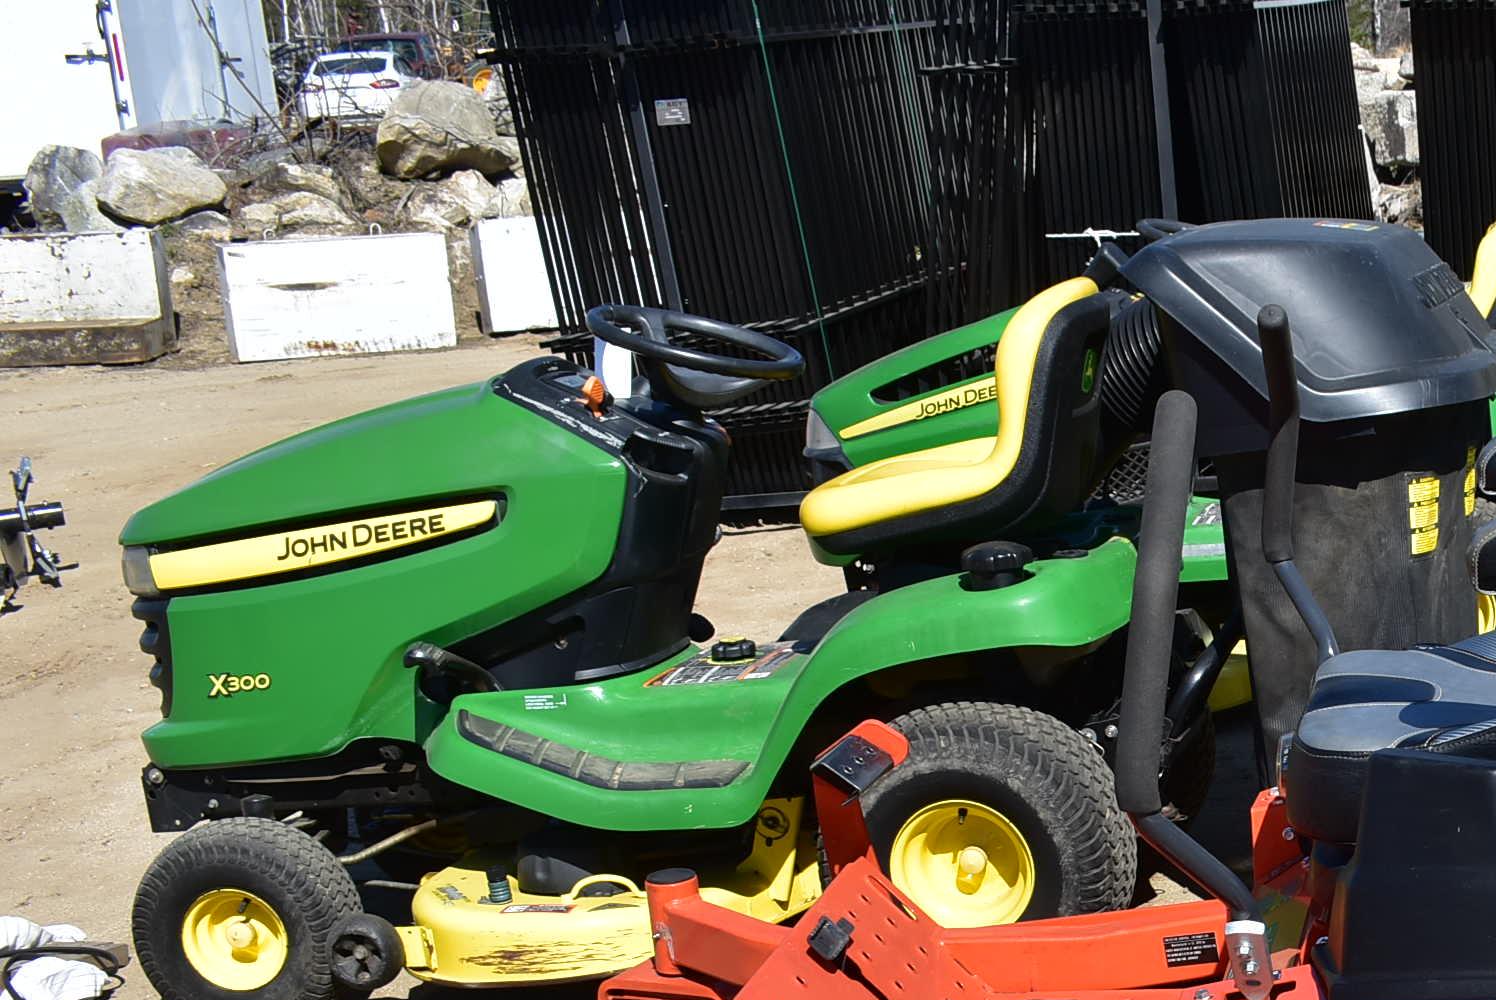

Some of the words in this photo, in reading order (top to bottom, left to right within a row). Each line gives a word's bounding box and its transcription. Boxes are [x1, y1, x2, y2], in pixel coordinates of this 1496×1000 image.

[916, 395, 961, 418] JOHN
[963, 385, 998, 404] DEE
[277, 531, 348, 561] JOHN
[352, 513, 446, 547] DEERE
[207, 673, 271, 697] X300
